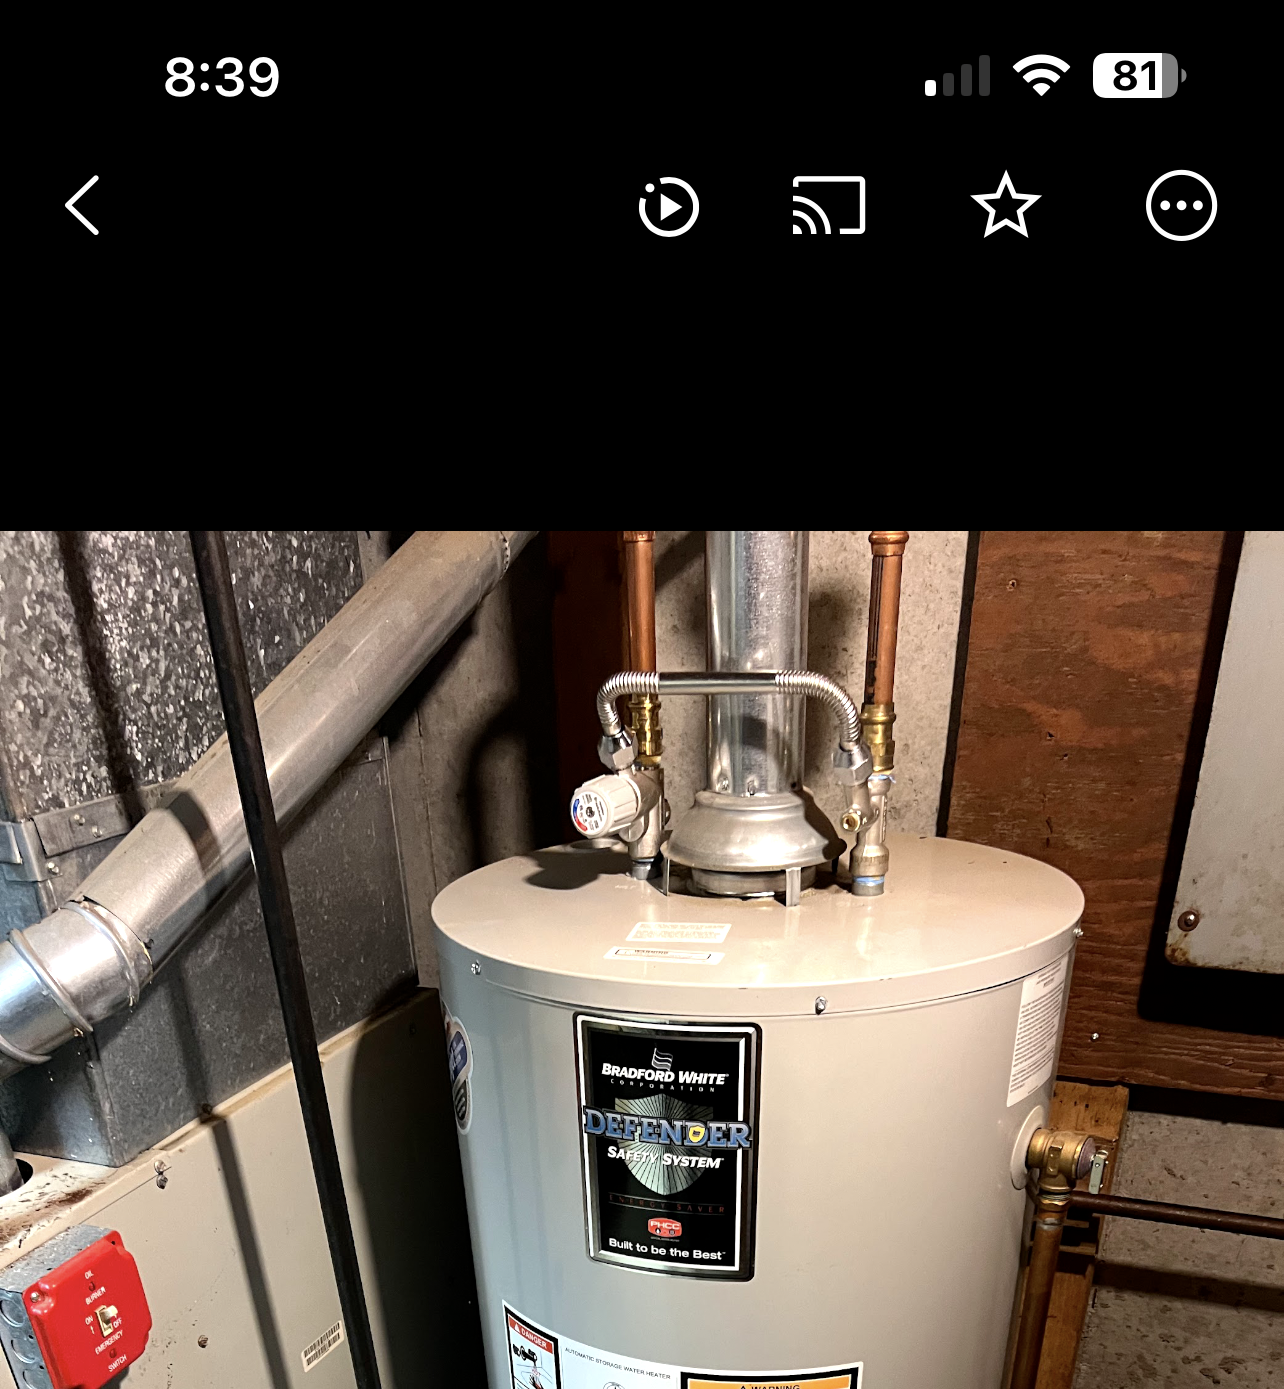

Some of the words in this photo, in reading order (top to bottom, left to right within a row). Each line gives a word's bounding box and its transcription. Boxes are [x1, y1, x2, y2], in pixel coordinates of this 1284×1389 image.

[601, 1063, 675, 1082] BRADFORD
[678, 1071, 726, 1085] WHITE
[611, 1078, 714, 1092] CORPORATION
[584, 1106, 751, 1148] DEFENDER
[607, 1146, 658, 1163] SAFETY
[662, 1153, 721, 1168] SYSTEM
[609, 1194, 666, 1208] ENERGY
[677, 1204, 724, 1213] SAVER
[651, 1221, 680, 1229] PHCC
[609, 1238, 633, 1251] Built
[636, 1242, 648, 1252] to
[651, 1245, 666, 1255] be
[670, 1248, 689, 1257] the
[693, 1250, 722, 1260] Best
[84, 1270, 94, 1279] OIL
[85, 1286, 106, 1305] BURNER
[85, 1316, 93, 1325] ON
[113, 1317, 122, 1328] OFF
[95, 1330, 123, 1355] EMERGENCY
[521, 1328, 547, 1349] DANGER
[108, 1354, 127, 1372] SWITCH
[565, 1347, 594, 1362] AUTOMATIC
[595, 1359, 622, 1370] STORAGE
[624, 1366, 645, 1375] WATER
[646, 1371, 671, 1380] HEATER
